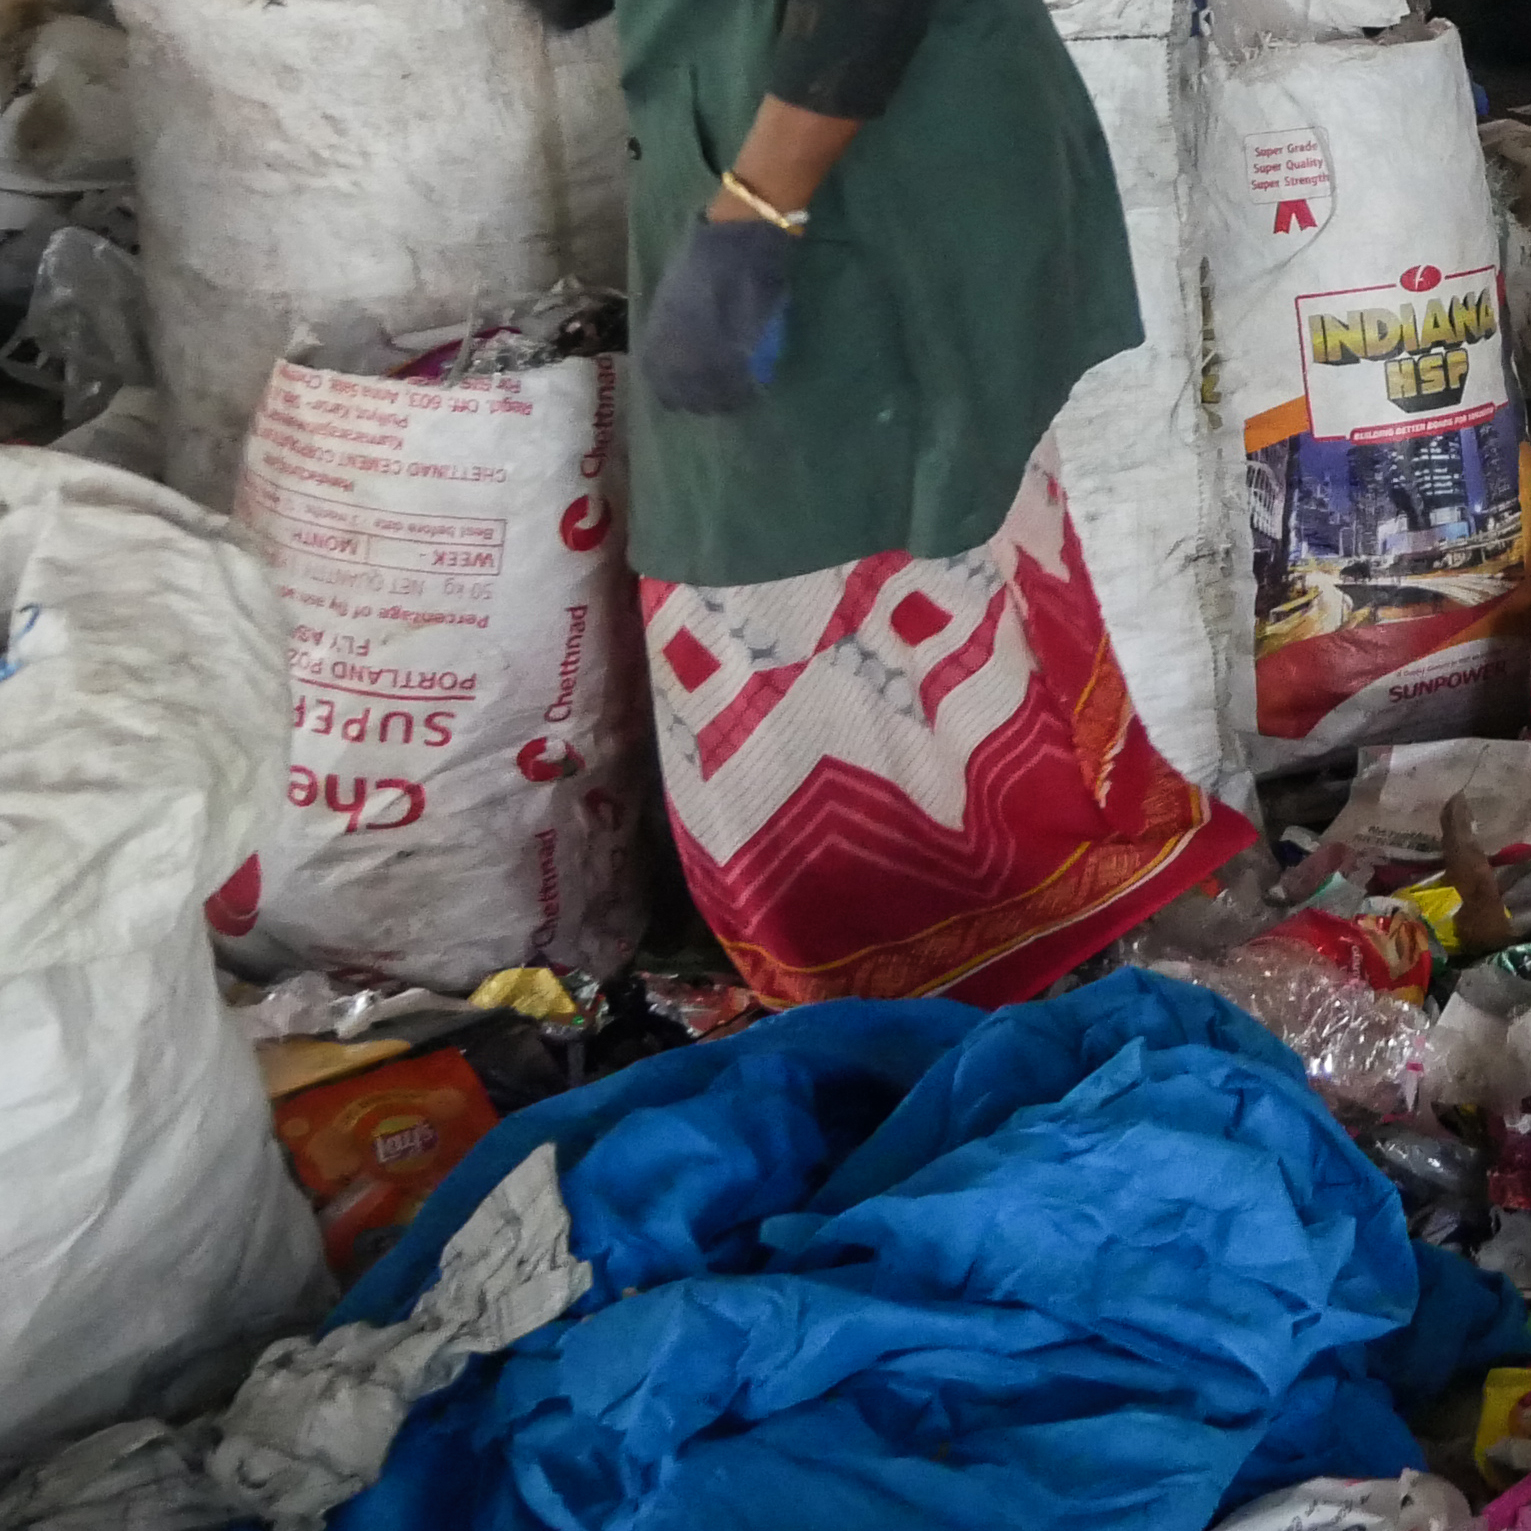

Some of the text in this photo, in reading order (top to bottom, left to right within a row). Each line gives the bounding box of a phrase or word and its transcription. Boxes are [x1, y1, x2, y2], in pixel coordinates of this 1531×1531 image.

[1254, 140, 1319, 159] Super Grade
[1252, 156, 1325, 175] Super Quality
[1250, 171, 1331, 192] Super Strength
[1308, 287, 1498, 367] INDIANA
[406, 461, 508, 483] CHETTINAD
[431, 549, 495, 568] WEEK
[378, 605, 490, 629] Percentage
[543, 603, 588, 723] Chettinad
[331, 660, 477, 692] PORTLAND
[286, 764, 427, 835] Che
